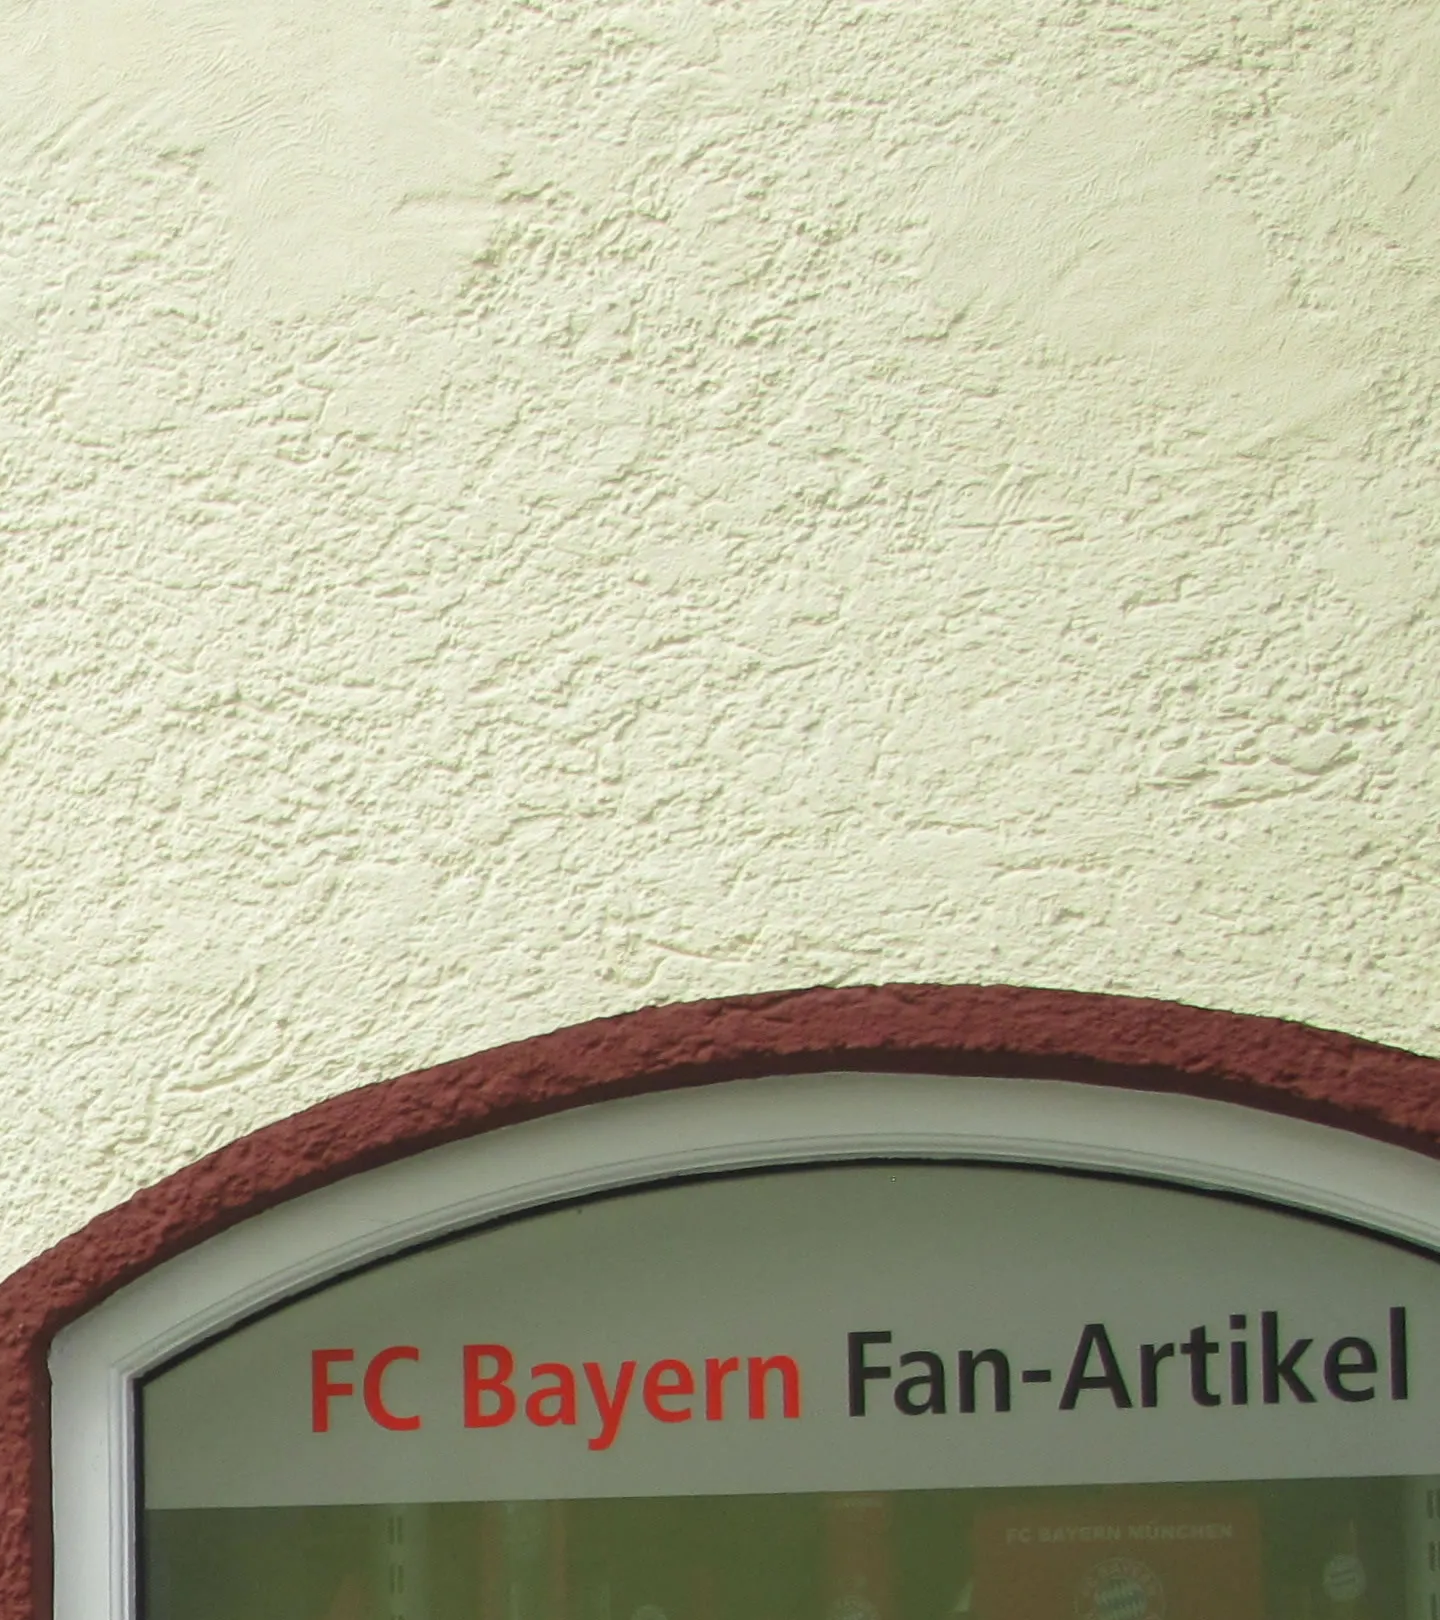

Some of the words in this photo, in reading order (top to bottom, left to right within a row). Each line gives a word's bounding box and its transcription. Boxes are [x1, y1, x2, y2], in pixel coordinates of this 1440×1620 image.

[310, 1345, 421, 1433] FC
[463, 1343, 801, 1452] Bayern
[847, 1306, 1410, 1418] Fan-Artikel
